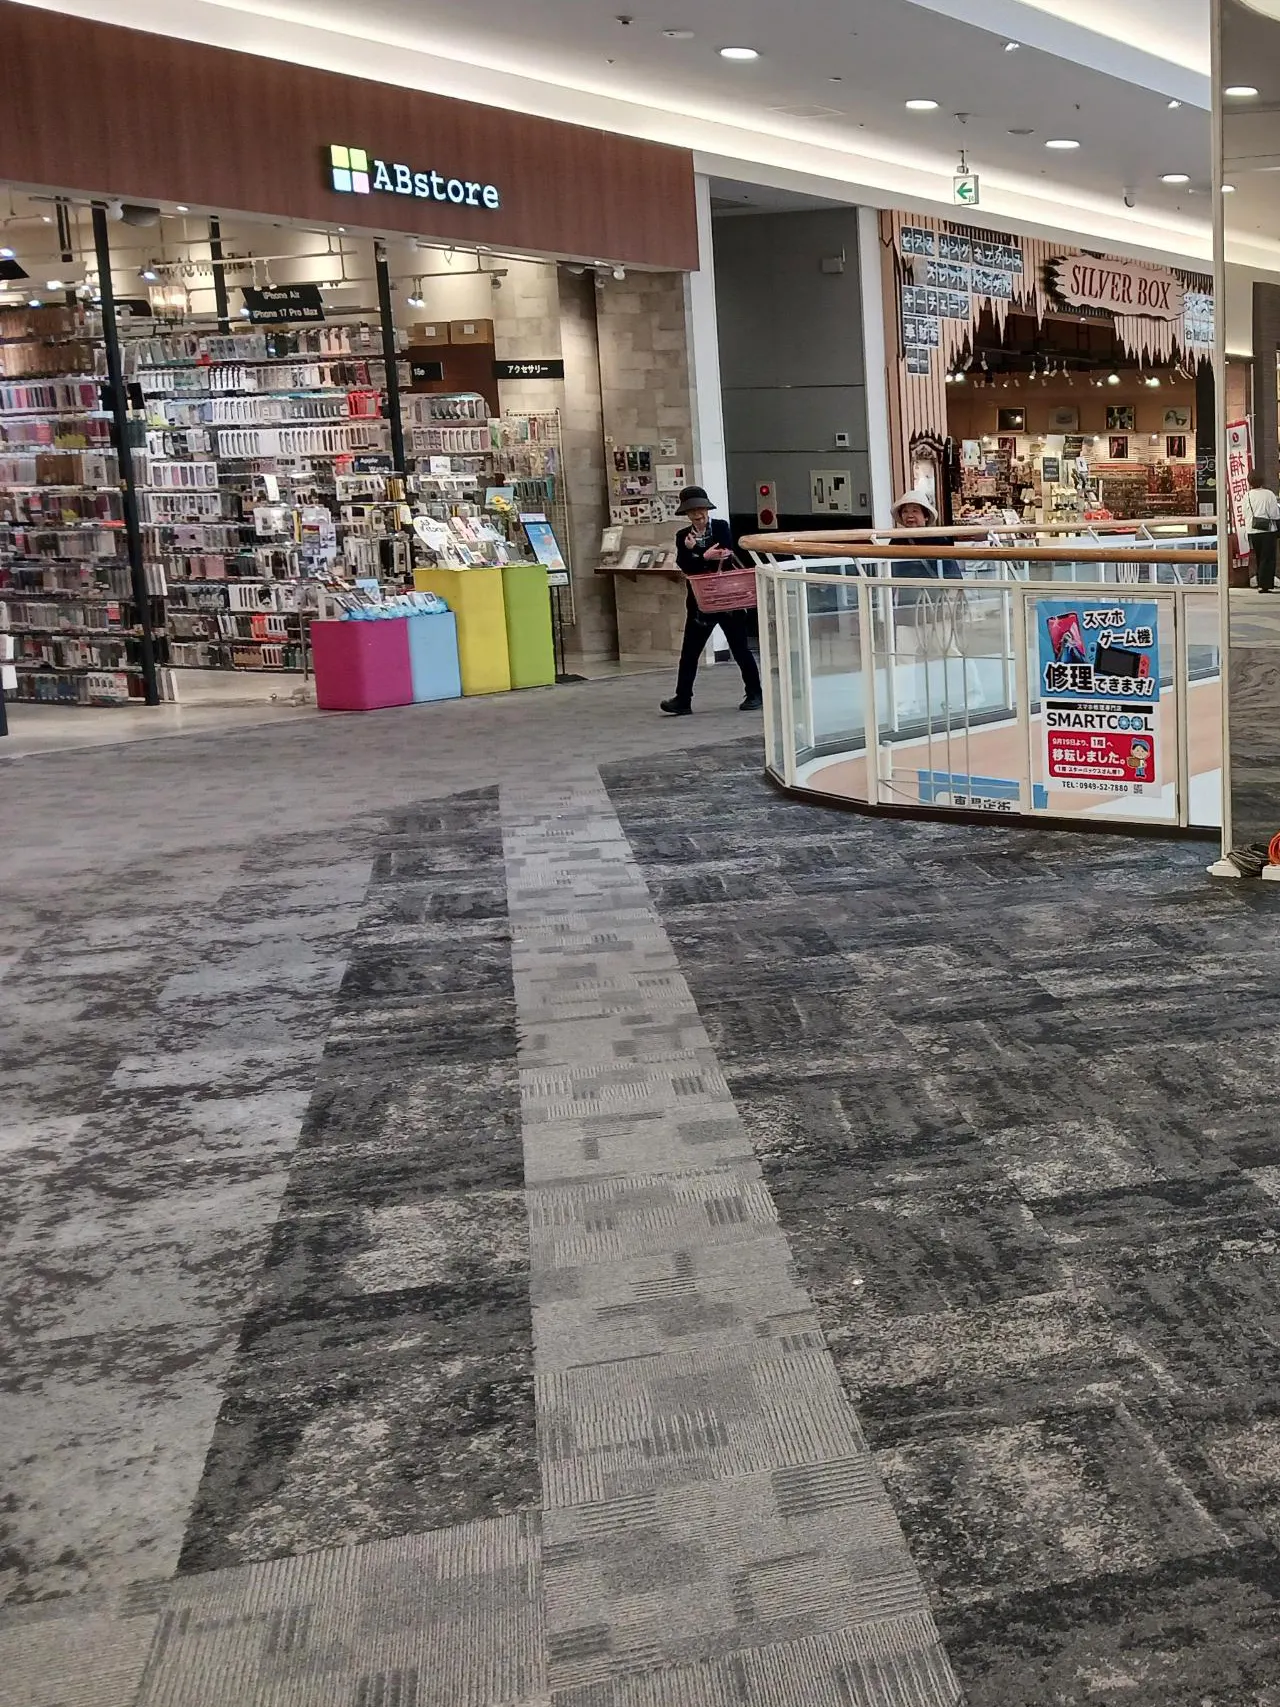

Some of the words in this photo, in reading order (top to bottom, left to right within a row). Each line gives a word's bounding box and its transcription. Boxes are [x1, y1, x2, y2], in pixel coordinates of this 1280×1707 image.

[373, 160, 500, 209] ABstore
[902, 233, 934, 251] ピアス
[263, 291, 287, 300] iPhone
[1071, 264, 1133, 304] SILVER
[1138, 277, 1171, 310] BOX
[904, 292, 969, 314] キーチェーン
[253, 310, 277, 318] iPhone
[279, 308, 287, 316] 17
[289, 308, 302, 316] Pro
[303, 307, 318, 316] Max
[507, 365, 548, 374] アクセサリー
[1084, 610, 1125, 628] スマホ
[1099, 629, 1152, 648] ゲーム機
[1047, 712, 1153, 731] SMARTCOOL
[1052, 749, 1126, 765] 移転しました。
